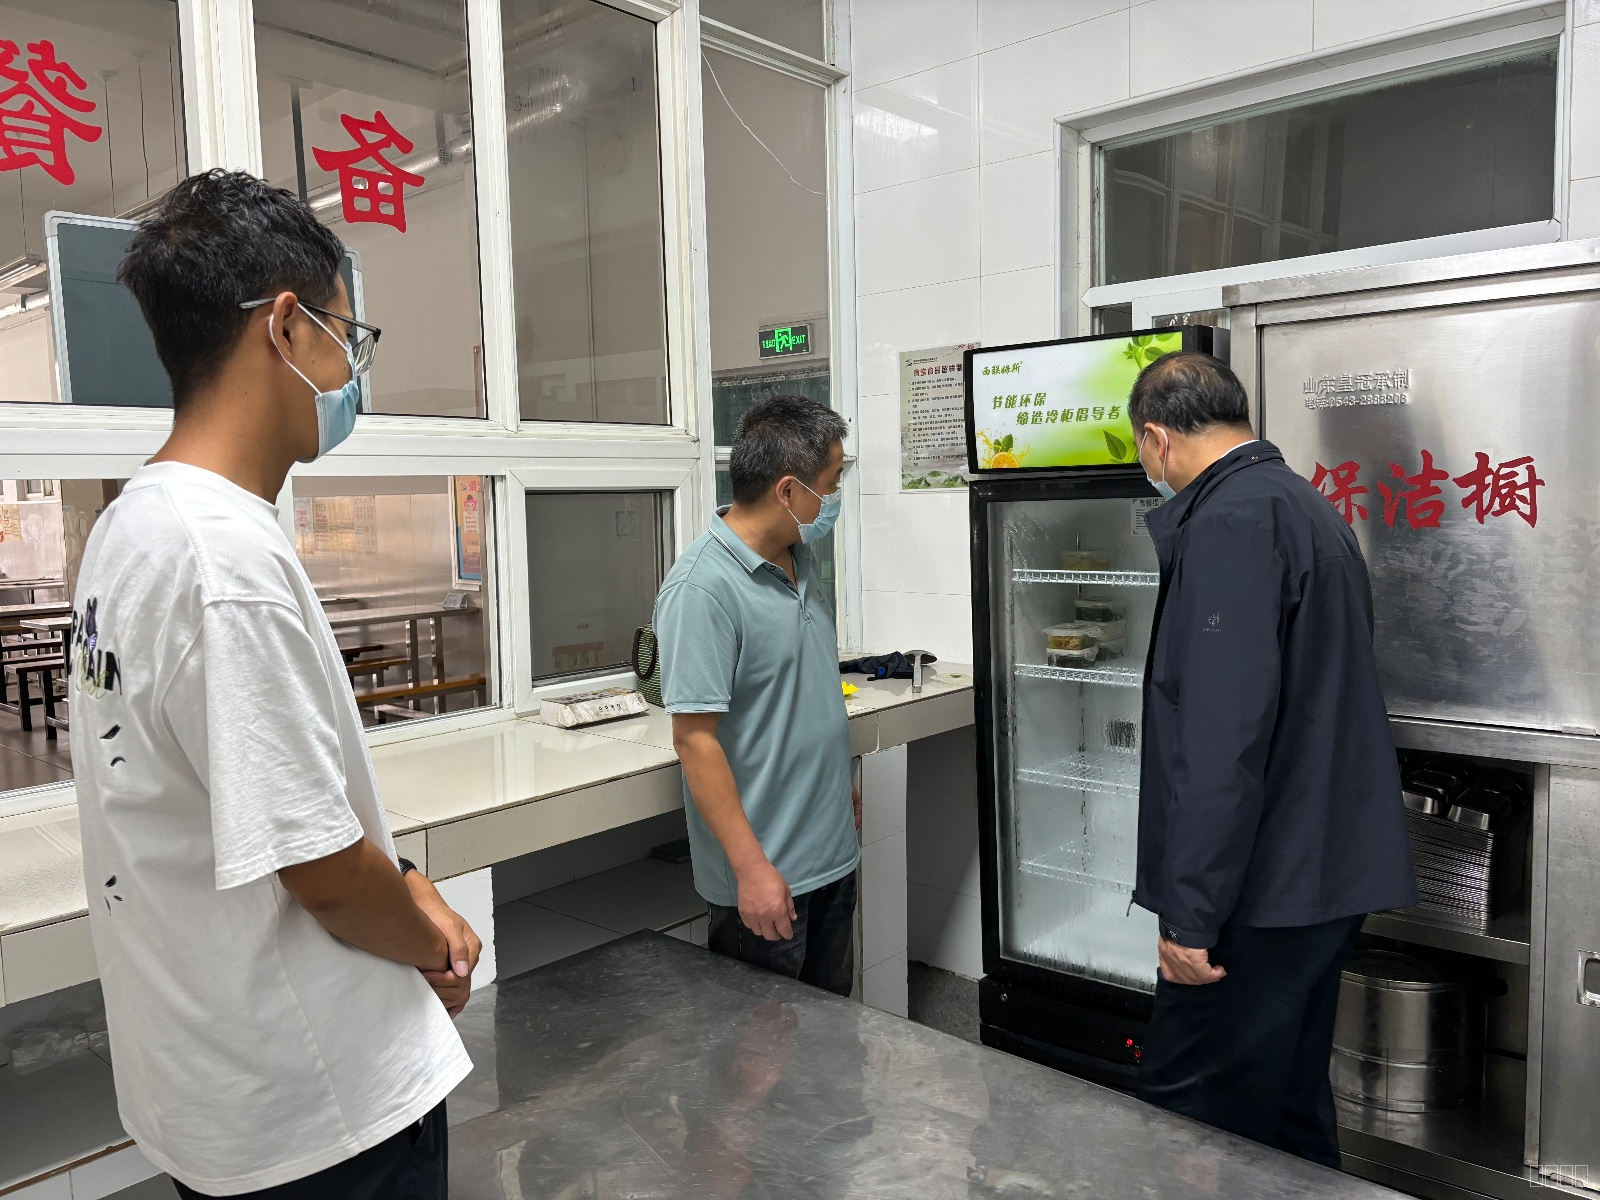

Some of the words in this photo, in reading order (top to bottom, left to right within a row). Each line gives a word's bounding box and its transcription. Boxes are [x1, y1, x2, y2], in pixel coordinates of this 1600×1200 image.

[792, 334, 806, 345] EXIT
[1303, 369, 1411, 394] 山东皇冠承制
[992, 392, 1047, 409] 节能环保
[1016, 405, 1121, 425] 缔造冷柜倡导者
